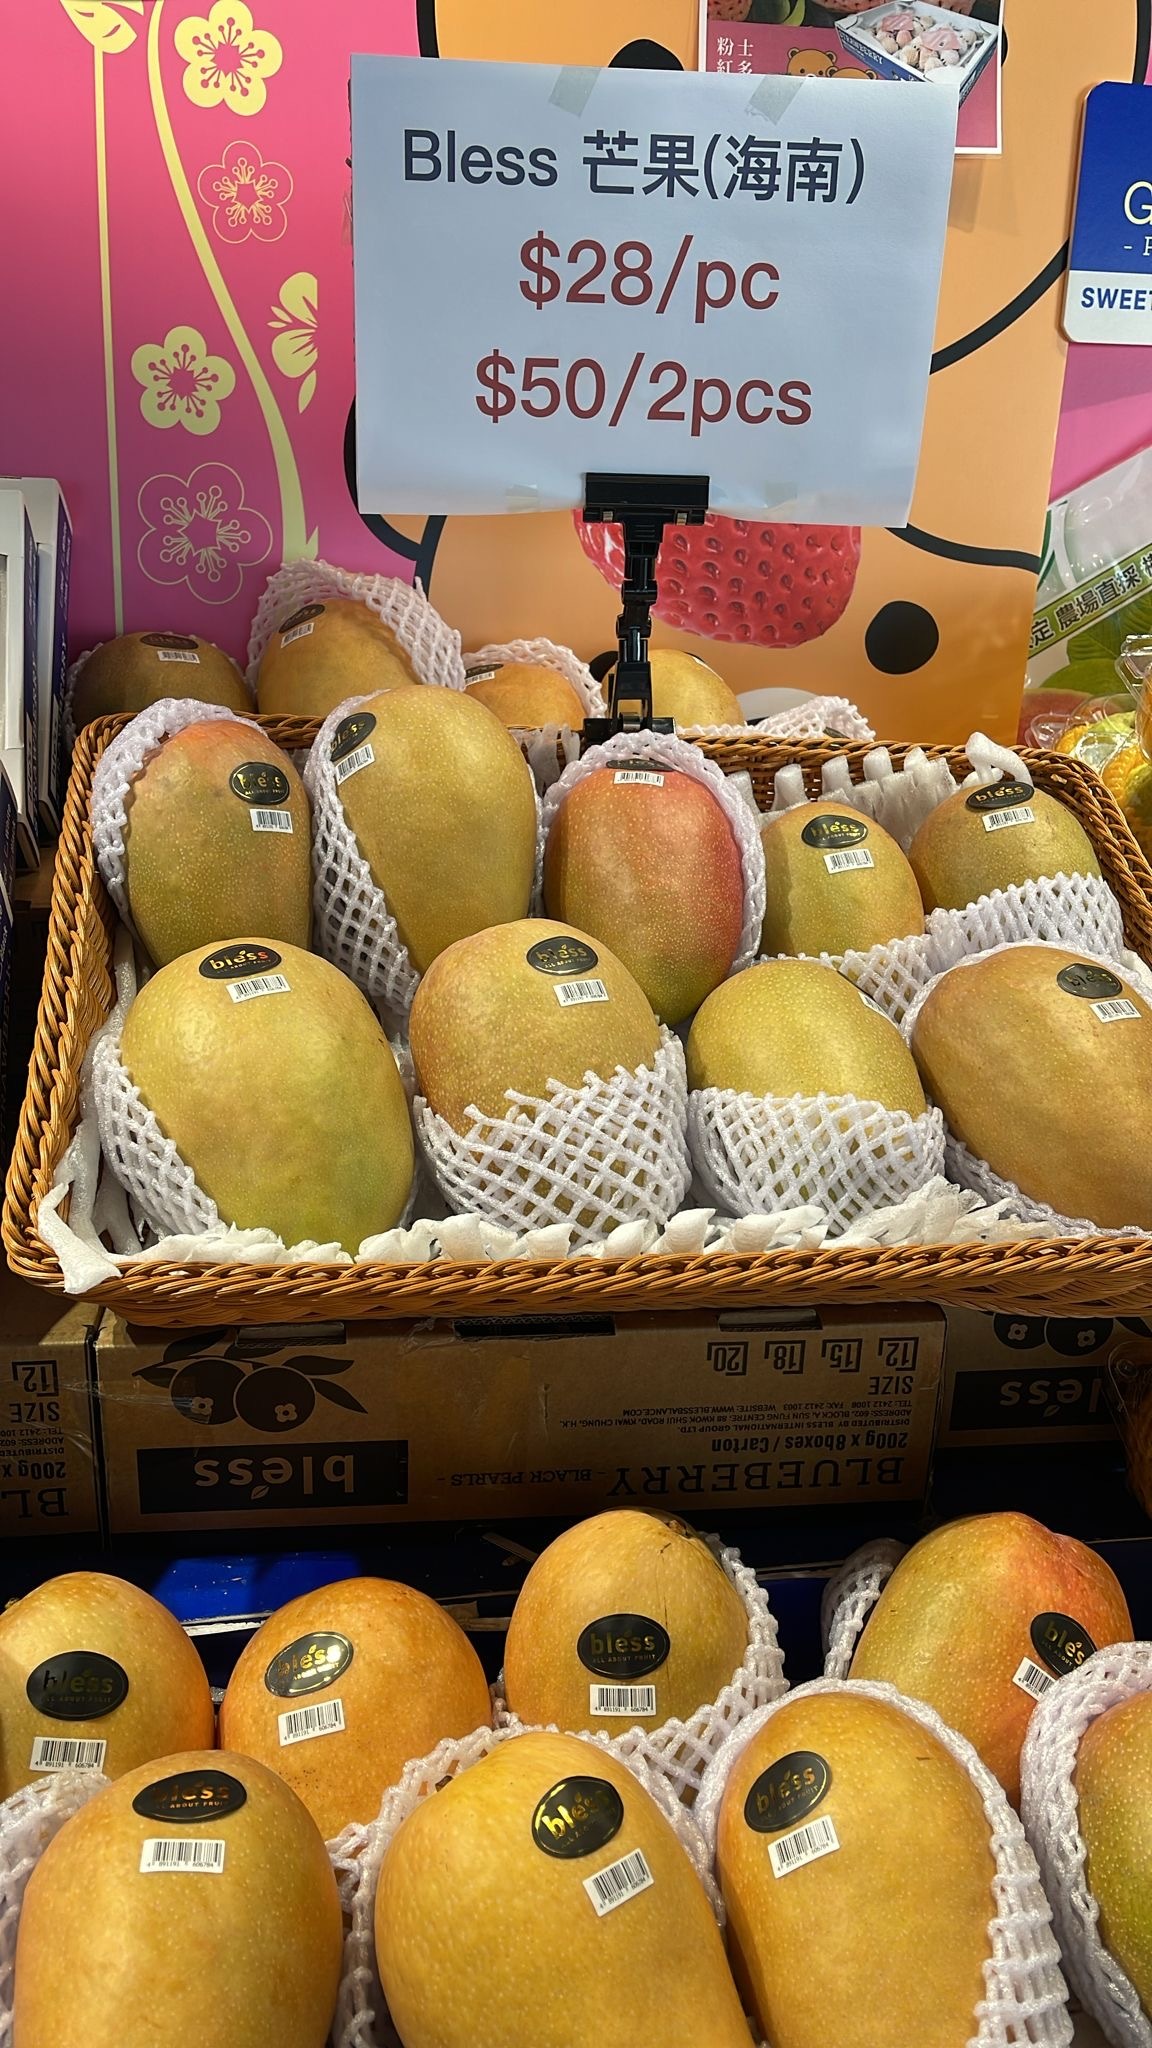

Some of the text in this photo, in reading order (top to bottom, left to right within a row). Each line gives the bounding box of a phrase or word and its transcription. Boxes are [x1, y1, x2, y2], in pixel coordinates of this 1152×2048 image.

[404, 128, 865, 205] Bless 芒果(海南)
[519, 231, 780, 323] $28/pc
[1081, 287, 1152, 310] SWEE
[476, 350, 812, 437] $50/2pcs
[1029, 618, 1055, 648] 定
[1055, 565, 1142, 631] 農場直採
[975, 786, 1024, 802] bless
[209, 950, 268, 970] bless
[536, 945, 587, 963] bless
[713, 1343, 909, 1372] 12 15 18 20
[22, 1366, 50, 1393] 12
[868, 1376, 913, 1395] SIZE
[999, 1378, 1103, 1416] less
[9, 1401, 60, 1423] SIZE
[622, 1406, 734, 1417] WWW.BLESSBALANCE.COM
[736, 1404, 776, 1413] WEBSITE:
[767, 1412, 791, 1421] FUNG
[792, 1412, 810, 1420] SUN
[821, 1410, 850, 1419] BLOCK
[870, 1408, 912, 1417] ADDRESS:
[614, 1418, 636, 1426] KWAI
[667, 1416, 687, 1424] SHUI
[677, 1418, 911, 1434] DISTRIBUTED BY BLESS INTERNATIONAL GROUP LTD.
[690, 1416, 715, 1424] KWOK
[711, 1438, 769, 1455] Carton
[851, 1435, 860, 1448] x
[866, 1431, 908, 1451] 200g
[17, 1460, 66, 1480] 200g
[193, 1454, 355, 1499] bless
[451, 1471, 523, 1487] PEARLS
[530, 1468, 592, 1484] BLACK
[607, 1456, 904, 1497] BLUEBERRY
[589, 1628, 655, 1655] bless
[1044, 1621, 1085, 1665] bles
[43, 1668, 113, 1694] bless
[756, 1767, 815, 1815] bless
